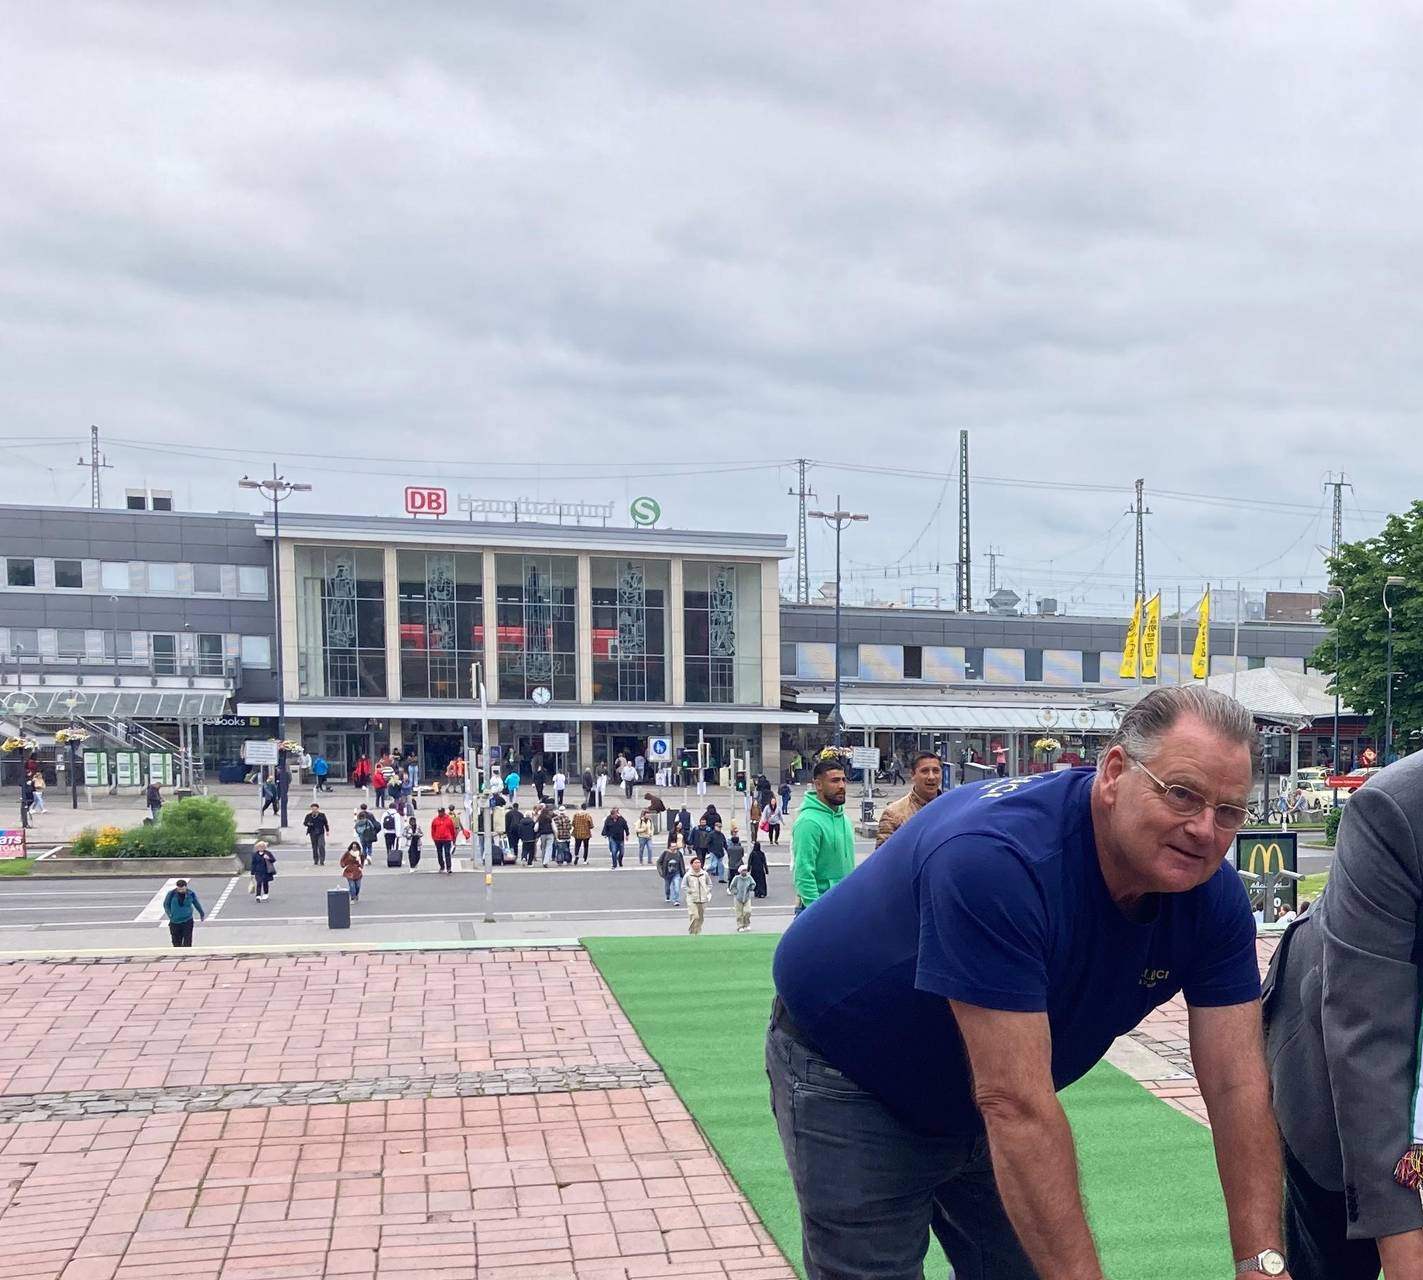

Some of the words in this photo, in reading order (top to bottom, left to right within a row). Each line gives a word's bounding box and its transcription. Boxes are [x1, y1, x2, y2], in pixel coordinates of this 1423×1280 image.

[410, 491, 442, 510] DB
[457, 494, 615, 518] Hauptbahnhof
[634, 499, 657, 522] S
[1262, 725, 1292, 736] KFC
